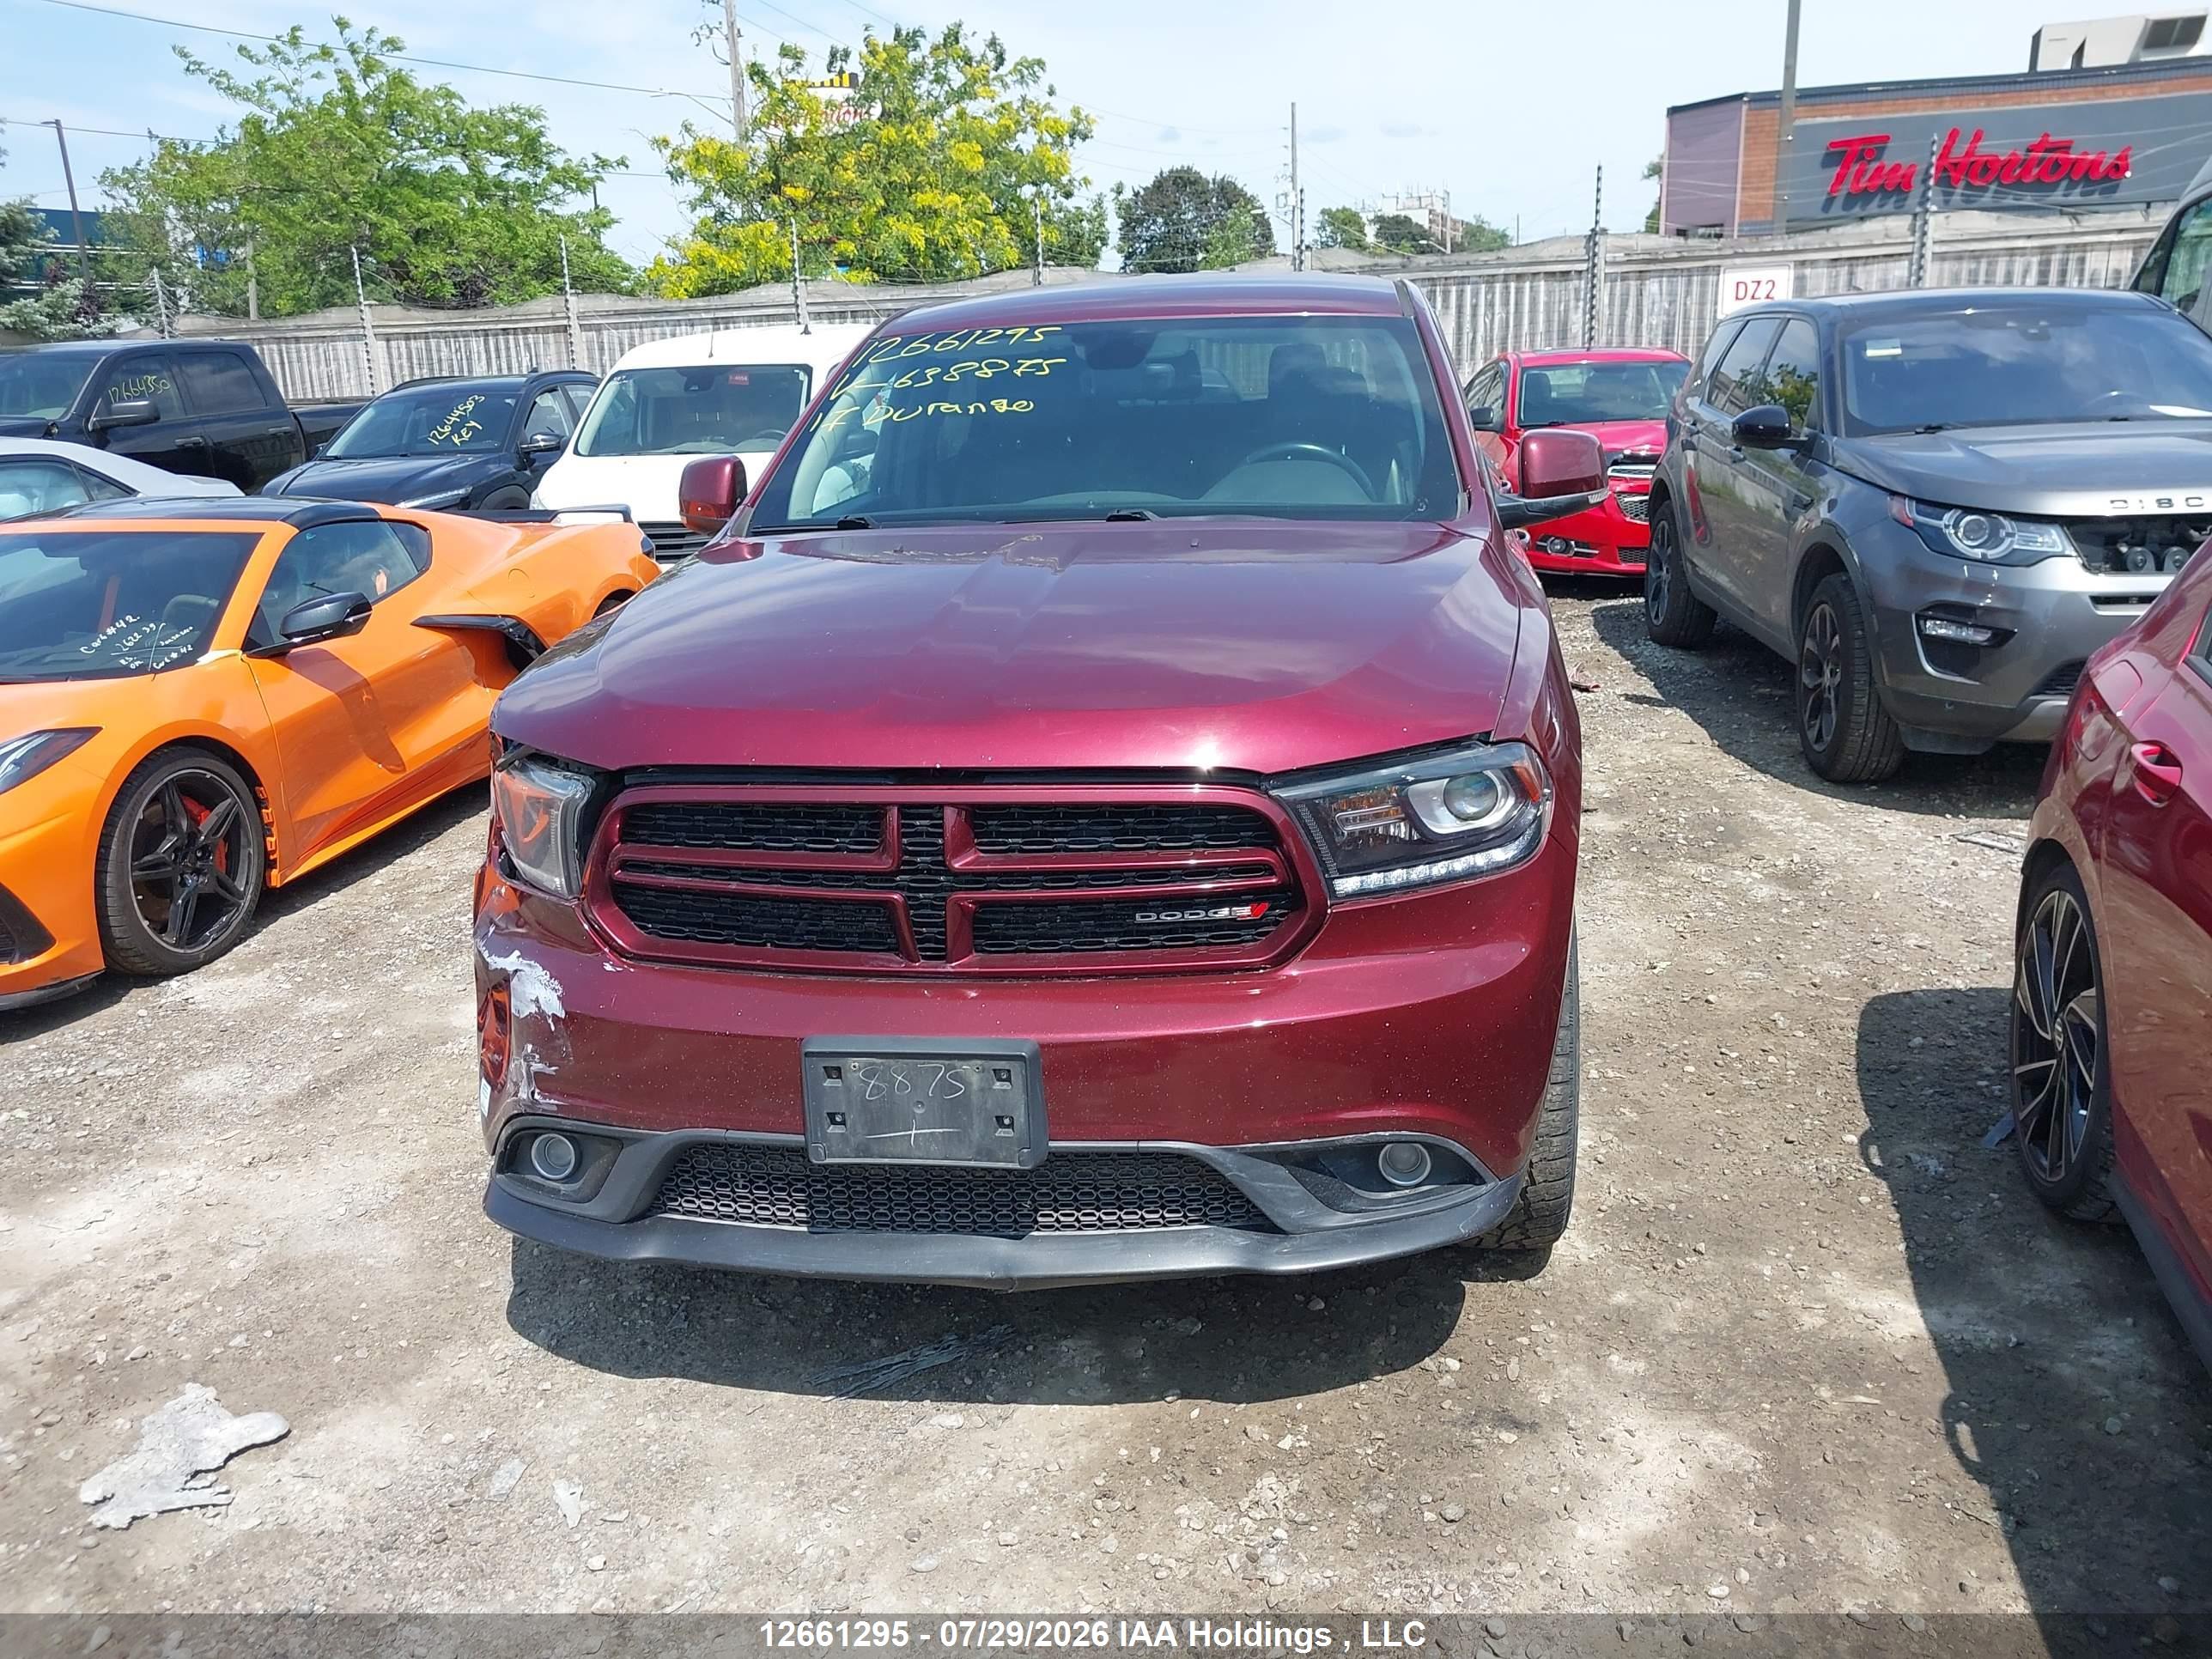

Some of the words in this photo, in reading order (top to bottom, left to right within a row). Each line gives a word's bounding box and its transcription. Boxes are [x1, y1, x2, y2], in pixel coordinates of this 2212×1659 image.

[1826, 134, 1918, 197] Tim
[1932, 127, 2132, 186] Hortons
[1735, 280, 1776, 301] DZ2
[852, 326, 1063, 368] 12661295
[1135, 907, 1252, 921] DODGE
